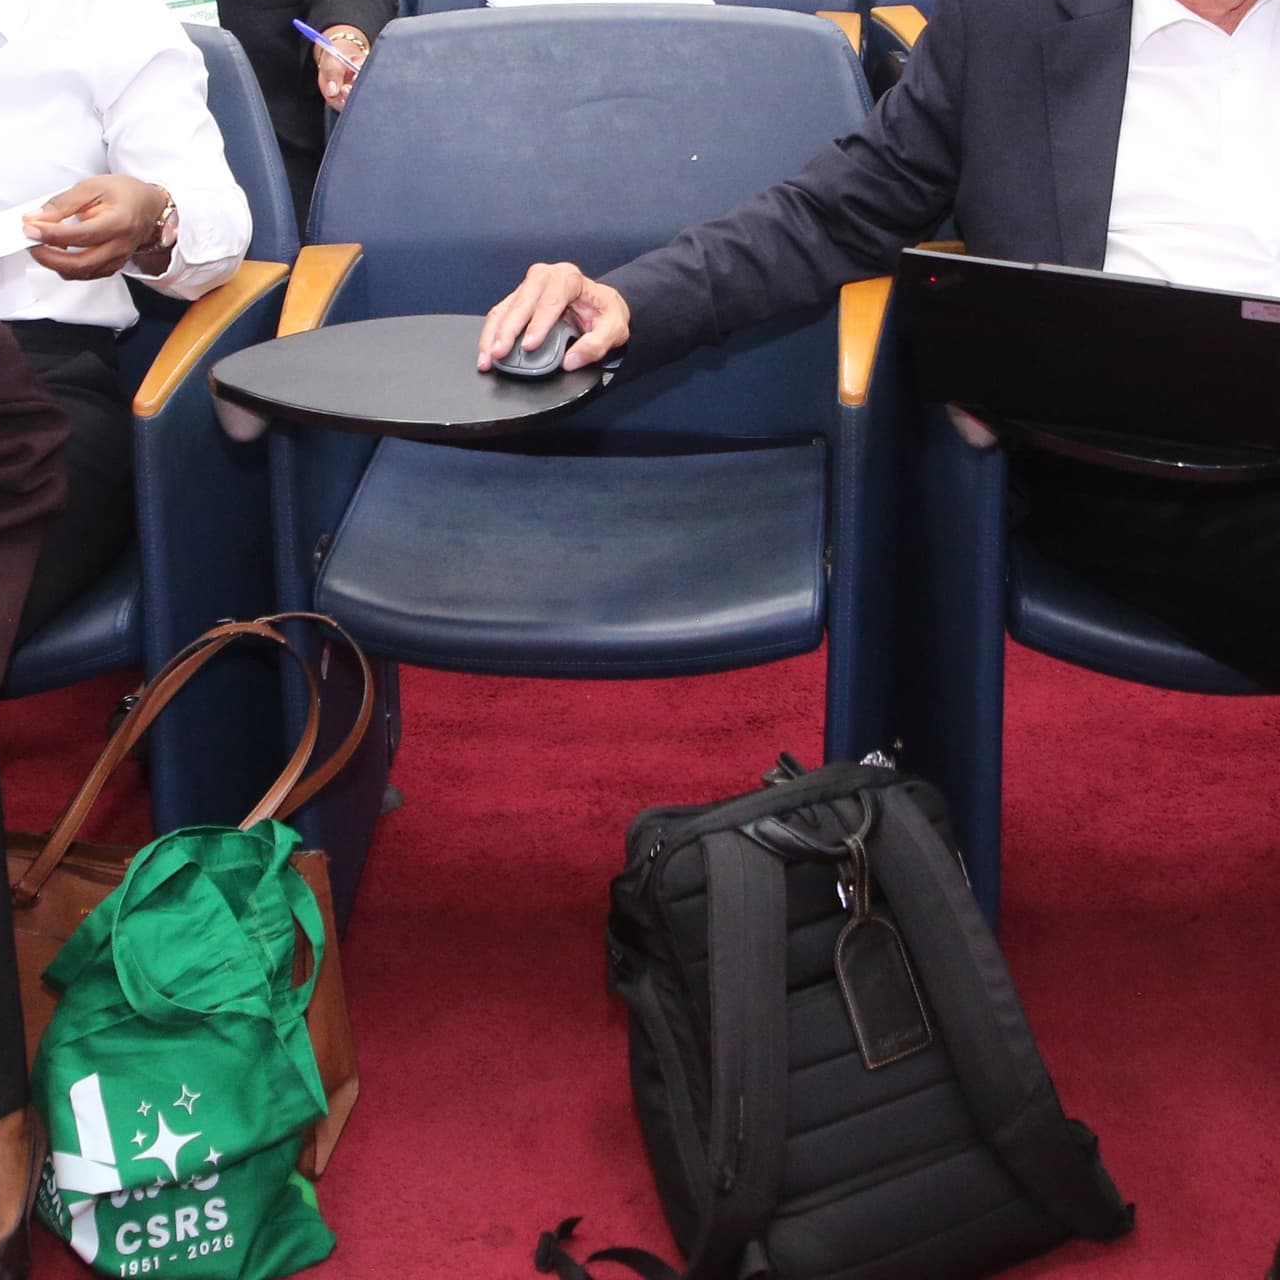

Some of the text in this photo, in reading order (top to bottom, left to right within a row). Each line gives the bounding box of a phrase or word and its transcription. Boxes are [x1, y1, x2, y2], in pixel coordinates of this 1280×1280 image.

[115, 1198, 228, 1255] CSRS
[120, 1254, 160, 1278] 1951
[187, 1234, 234, 1260] 2026
